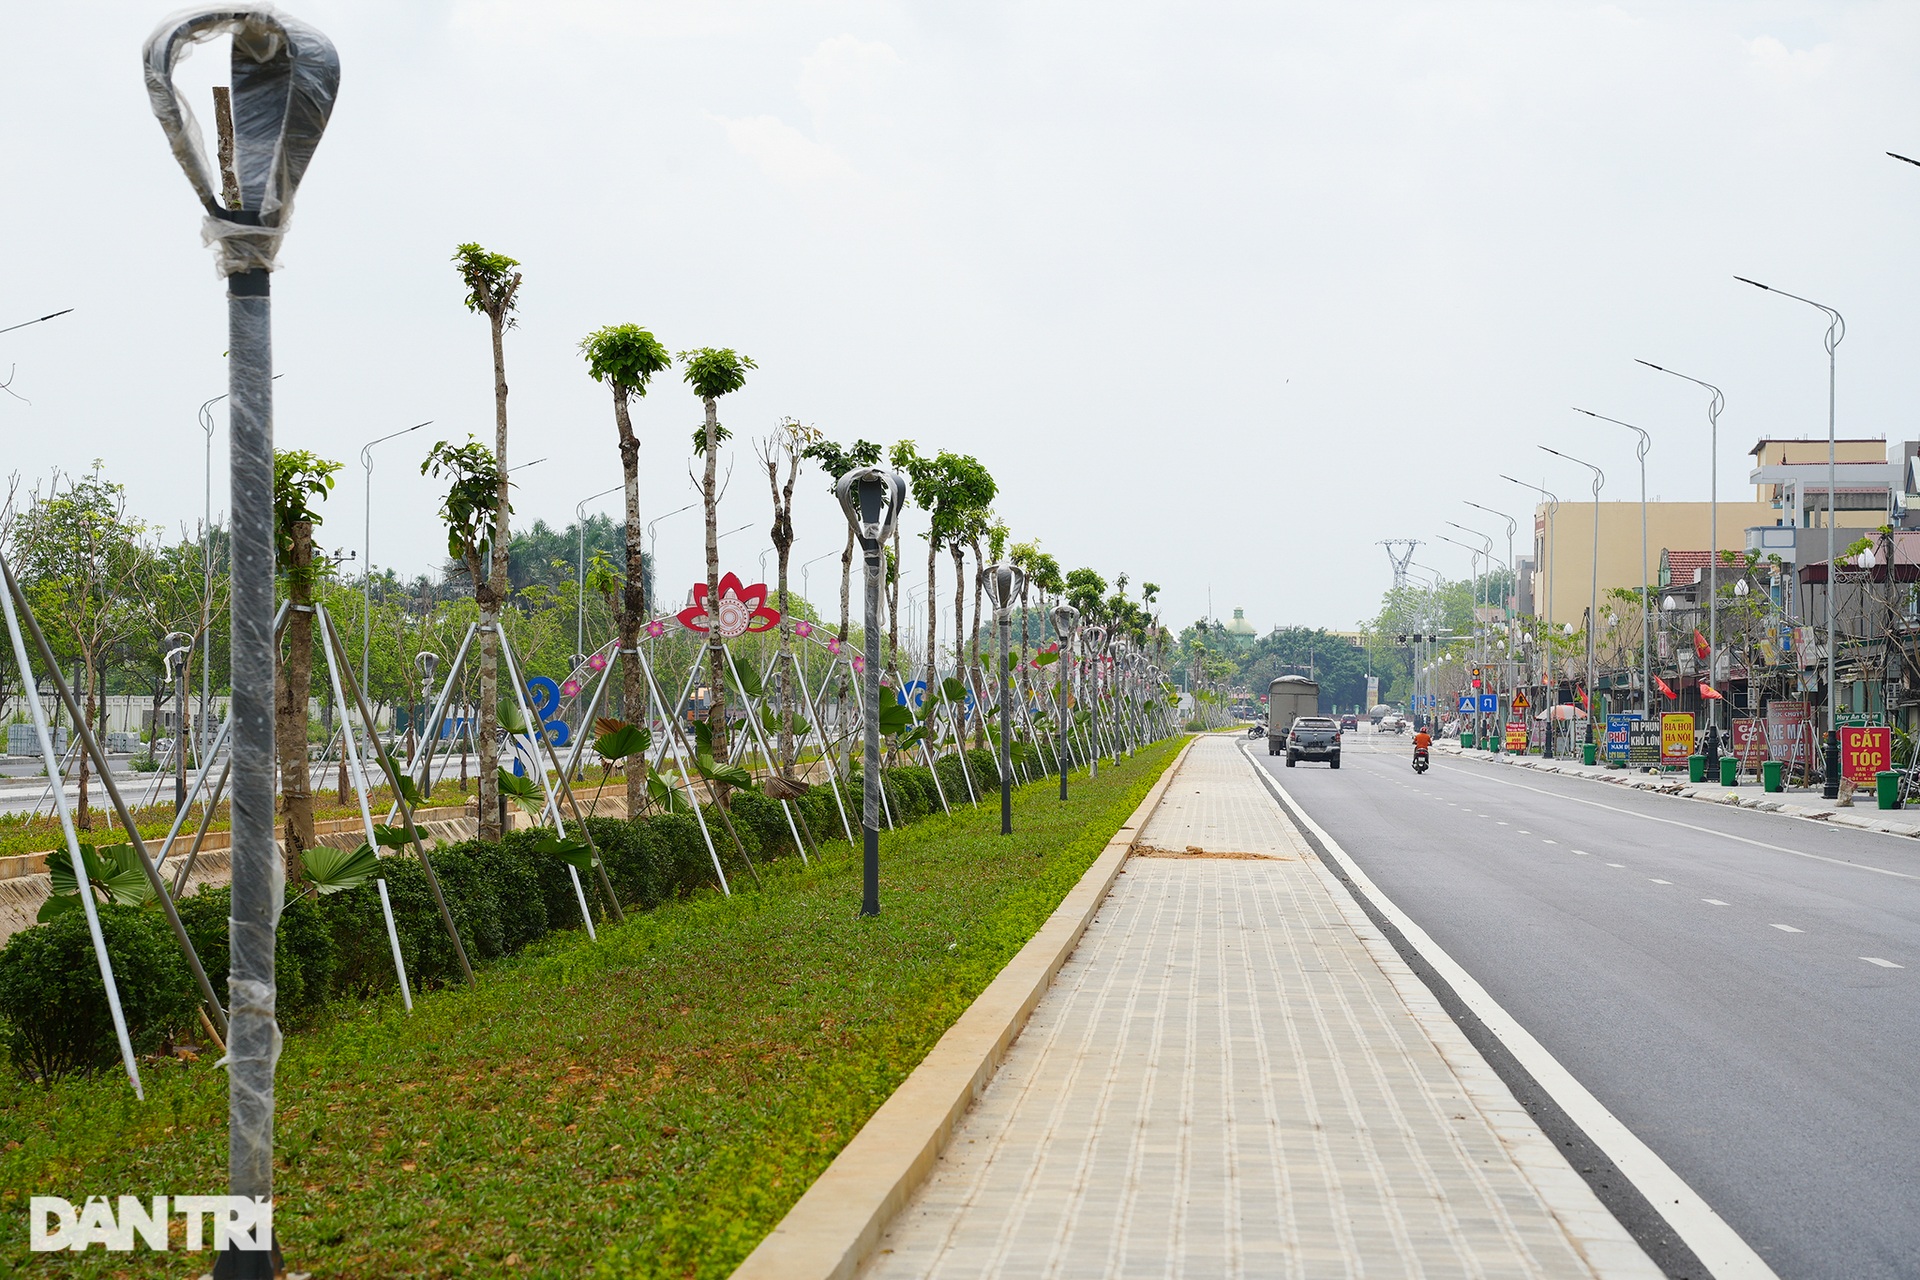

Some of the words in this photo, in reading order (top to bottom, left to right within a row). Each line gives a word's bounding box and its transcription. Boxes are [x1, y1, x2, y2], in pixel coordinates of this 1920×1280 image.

[1631, 721, 1639, 732] IN
[1640, 721, 1660, 732] PHUN
[1664, 723, 1677, 731] BIA
[1772, 724, 1785, 741] XE
[1608, 727, 1627, 743] PHỞ
[1850, 728, 1882, 748] CẮT
[1850, 749, 1882, 767] TÓC
